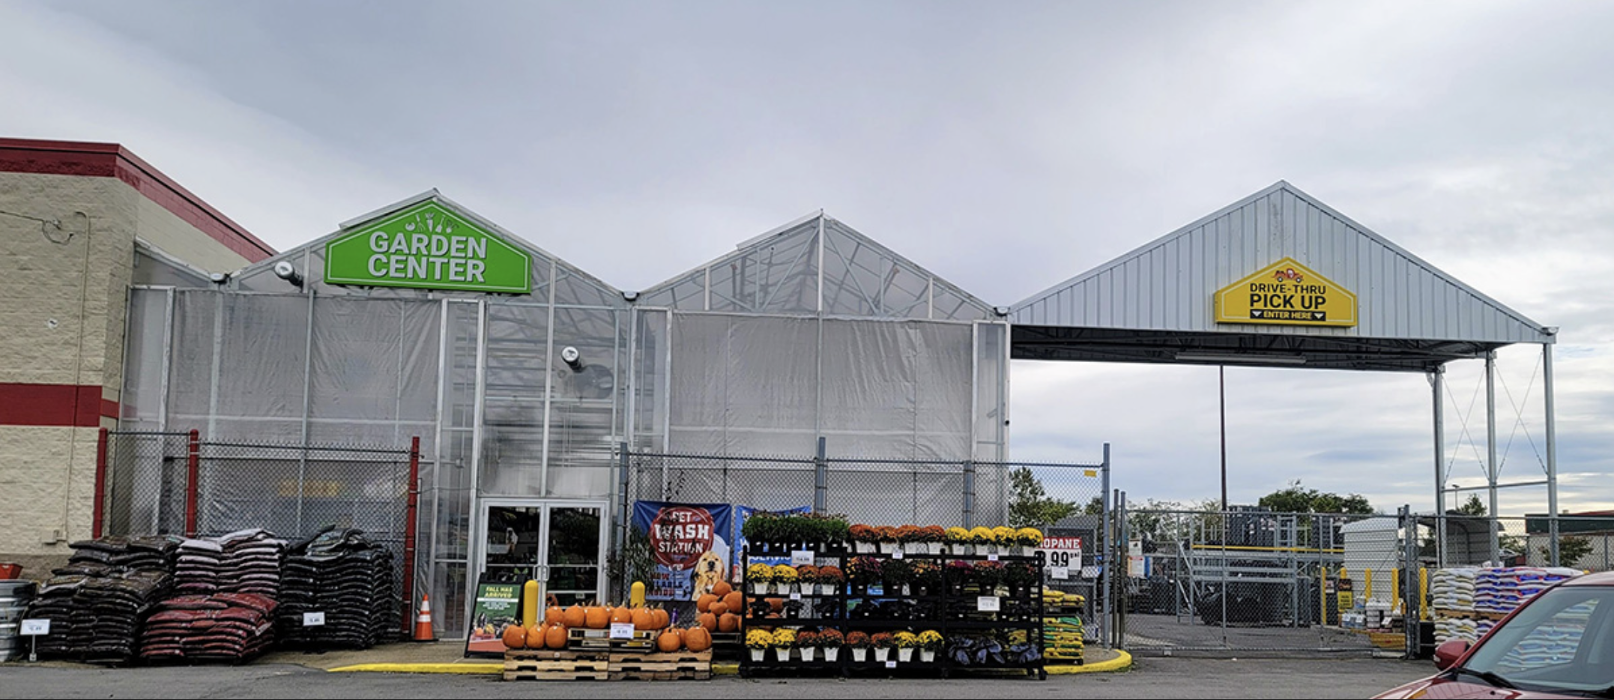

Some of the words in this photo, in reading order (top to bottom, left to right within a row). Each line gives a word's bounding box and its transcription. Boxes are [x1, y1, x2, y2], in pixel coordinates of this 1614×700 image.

[369, 231, 487, 259] GARDEN
[368, 253, 485, 282] CENTER
[1250, 283, 1326, 295] DRIVE-THRU
[1250, 293, 1294, 308] PICK
[1301, 295, 1326, 310] UP
[1263, 310, 1290, 319] ENTER
[1291, 311, 1313, 320] HERE
[672, 511, 692, 522] PET
[654, 524, 709, 539] WASH
[658, 542, 704, 553] STATION
[1040, 538, 1080, 549] OPANE
